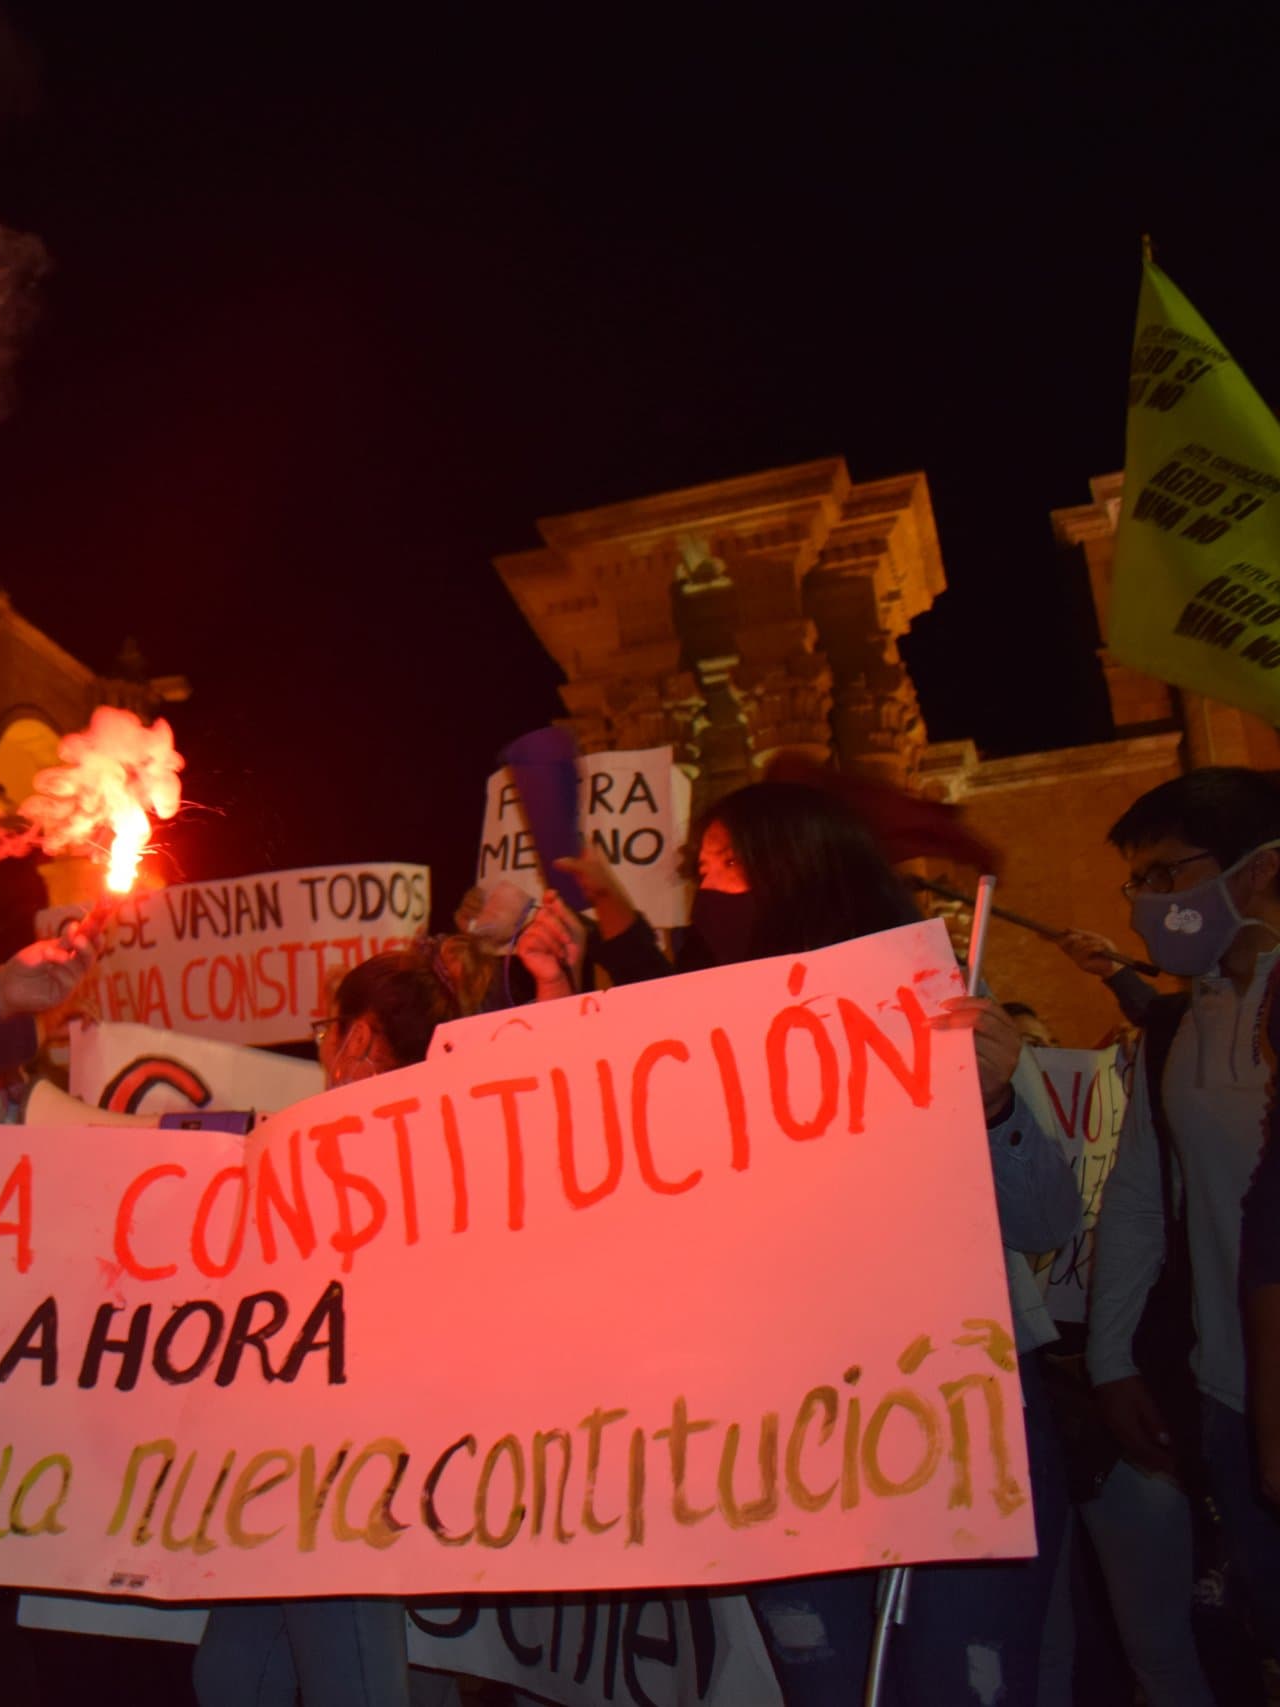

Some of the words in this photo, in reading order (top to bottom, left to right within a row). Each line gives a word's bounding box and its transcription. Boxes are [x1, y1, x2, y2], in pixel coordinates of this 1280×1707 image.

[1150, 460, 1228, 507] AGRO
[1220, 492, 1265, 520] SI
[1195, 575, 1280, 627] AGRO
[165, 880, 285, 940] VAYAN
[300, 872, 426, 923] TODOS
[106, 1436, 412, 1556] nueva
